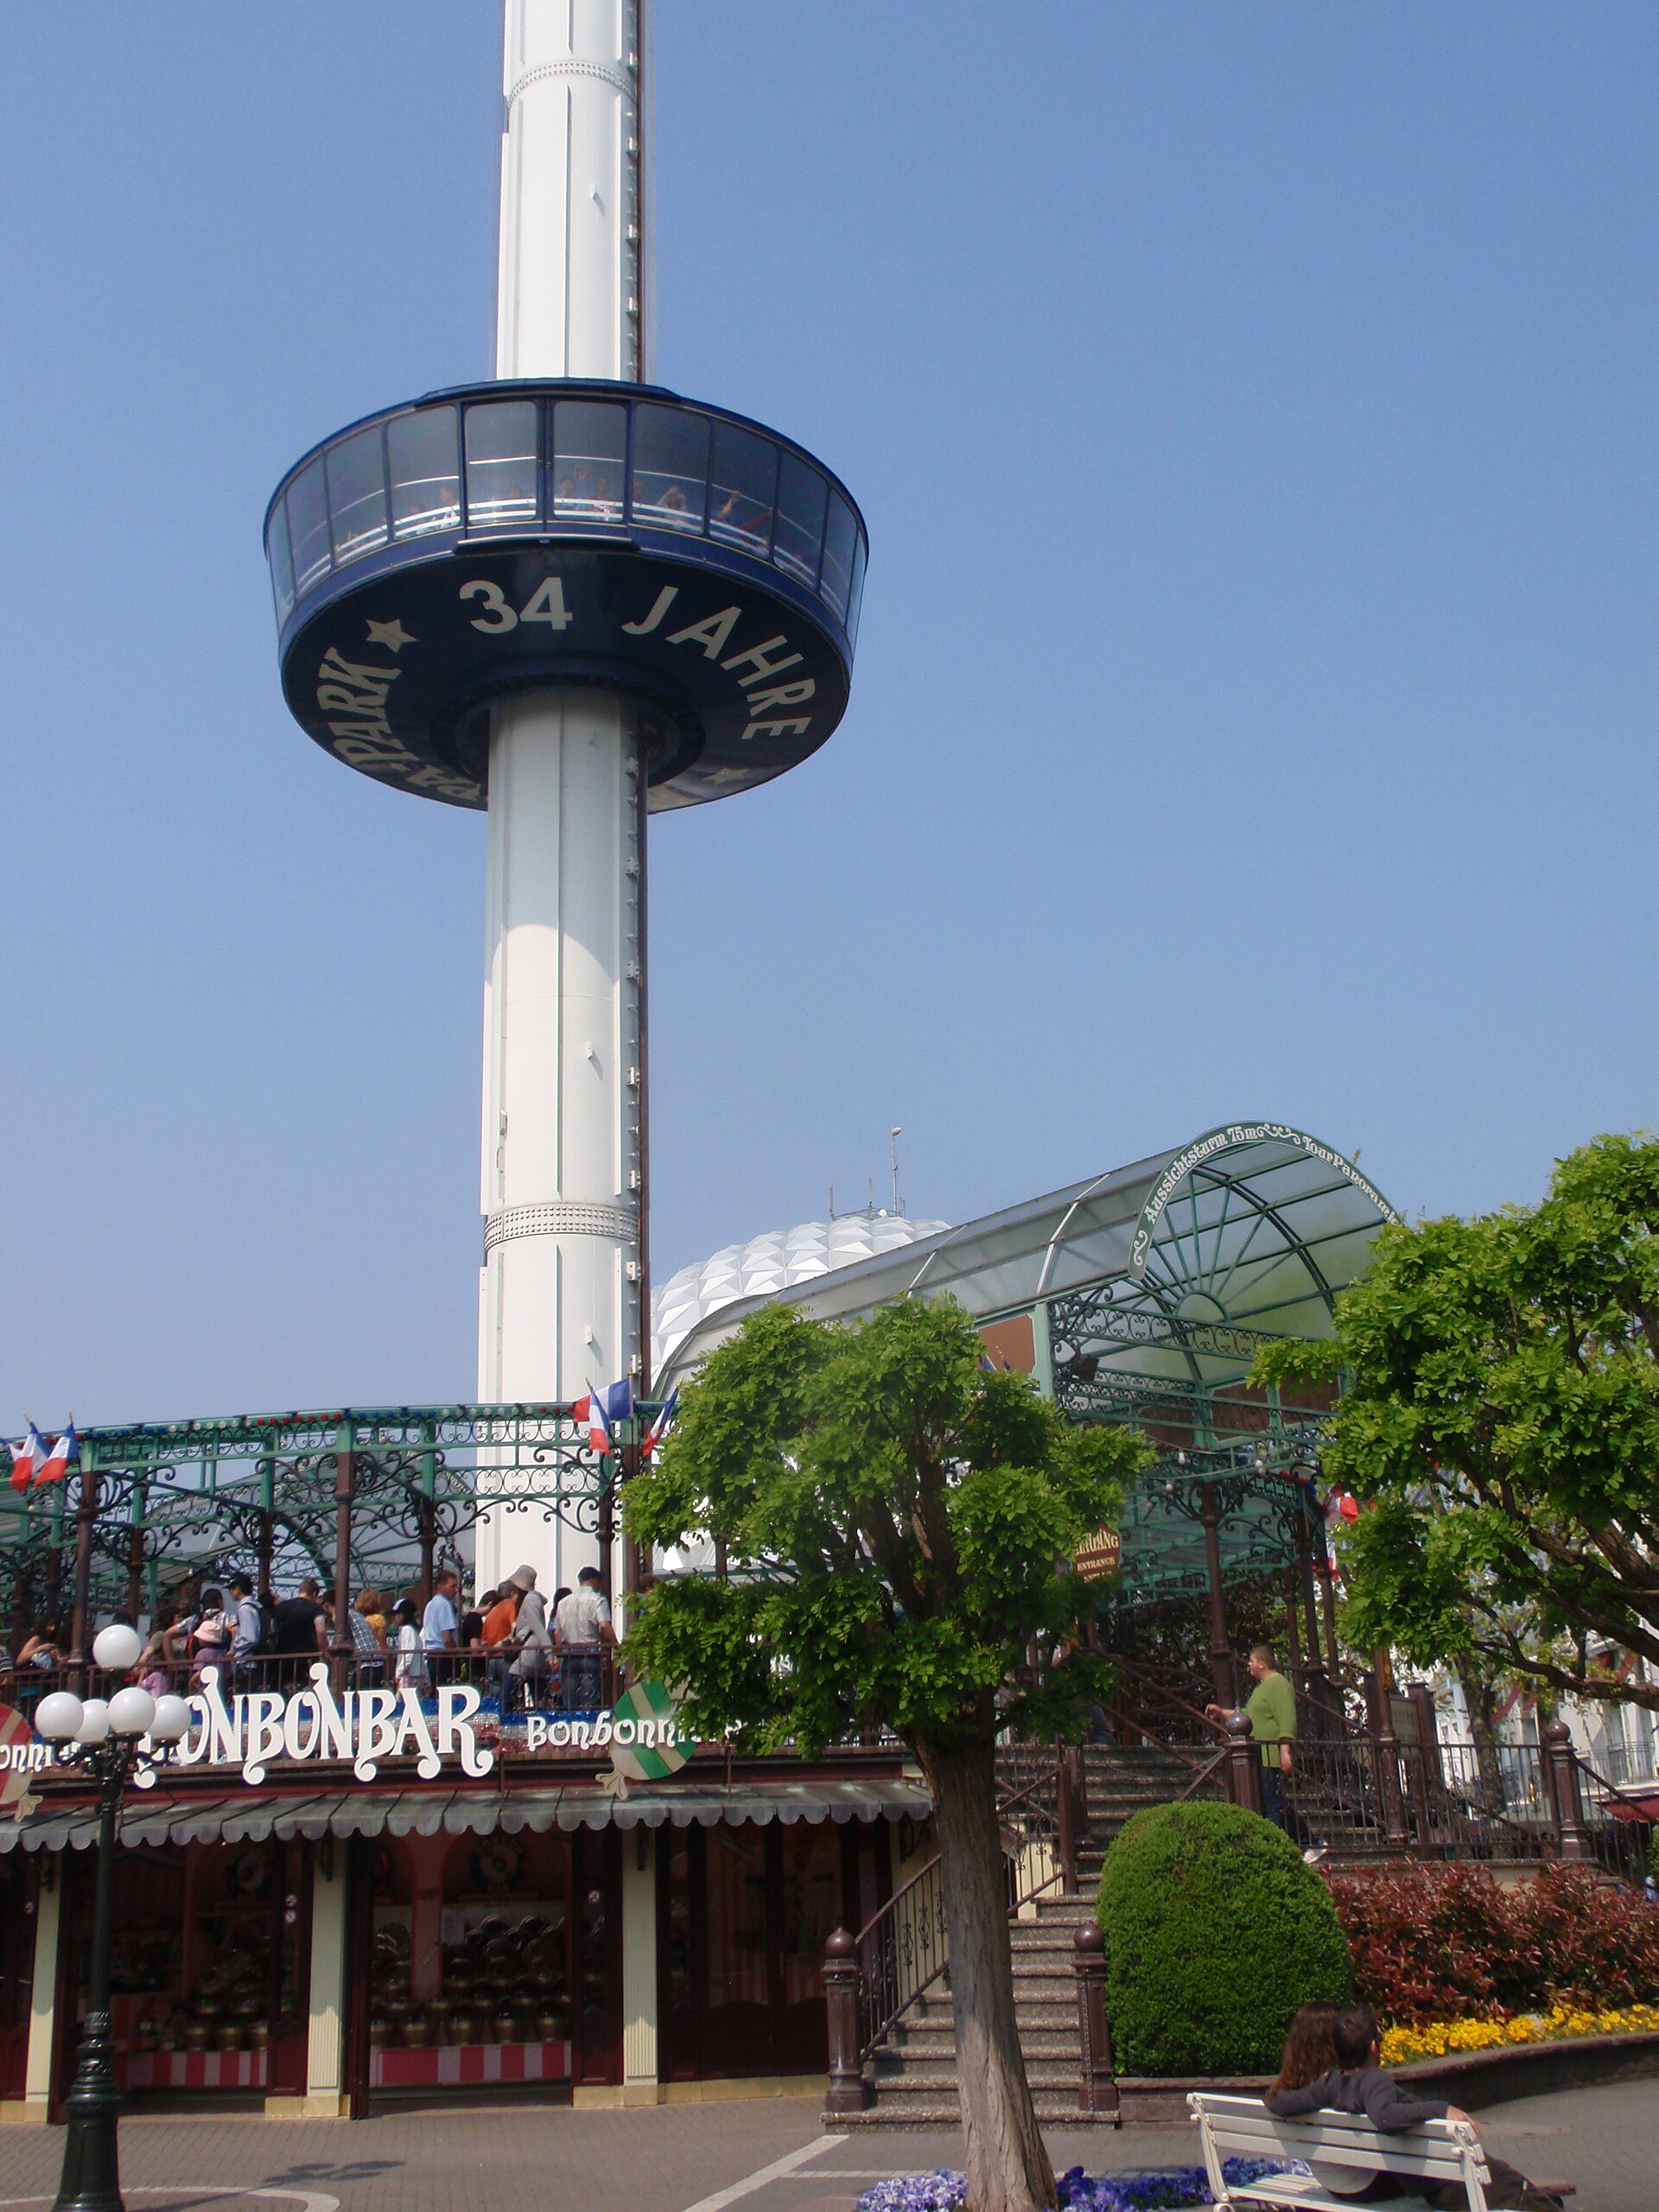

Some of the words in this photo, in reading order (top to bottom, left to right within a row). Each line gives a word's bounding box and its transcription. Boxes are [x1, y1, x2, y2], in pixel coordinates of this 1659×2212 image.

[458, 577, 573, 634] 34
[621, 585, 816, 741] JAHRE
[1144, 1133, 1229, 1225] Aussichtsturm
[1302, 1135, 1334, 1163] Tour
[1077, 1556, 1115, 1571] ENTRANCE
